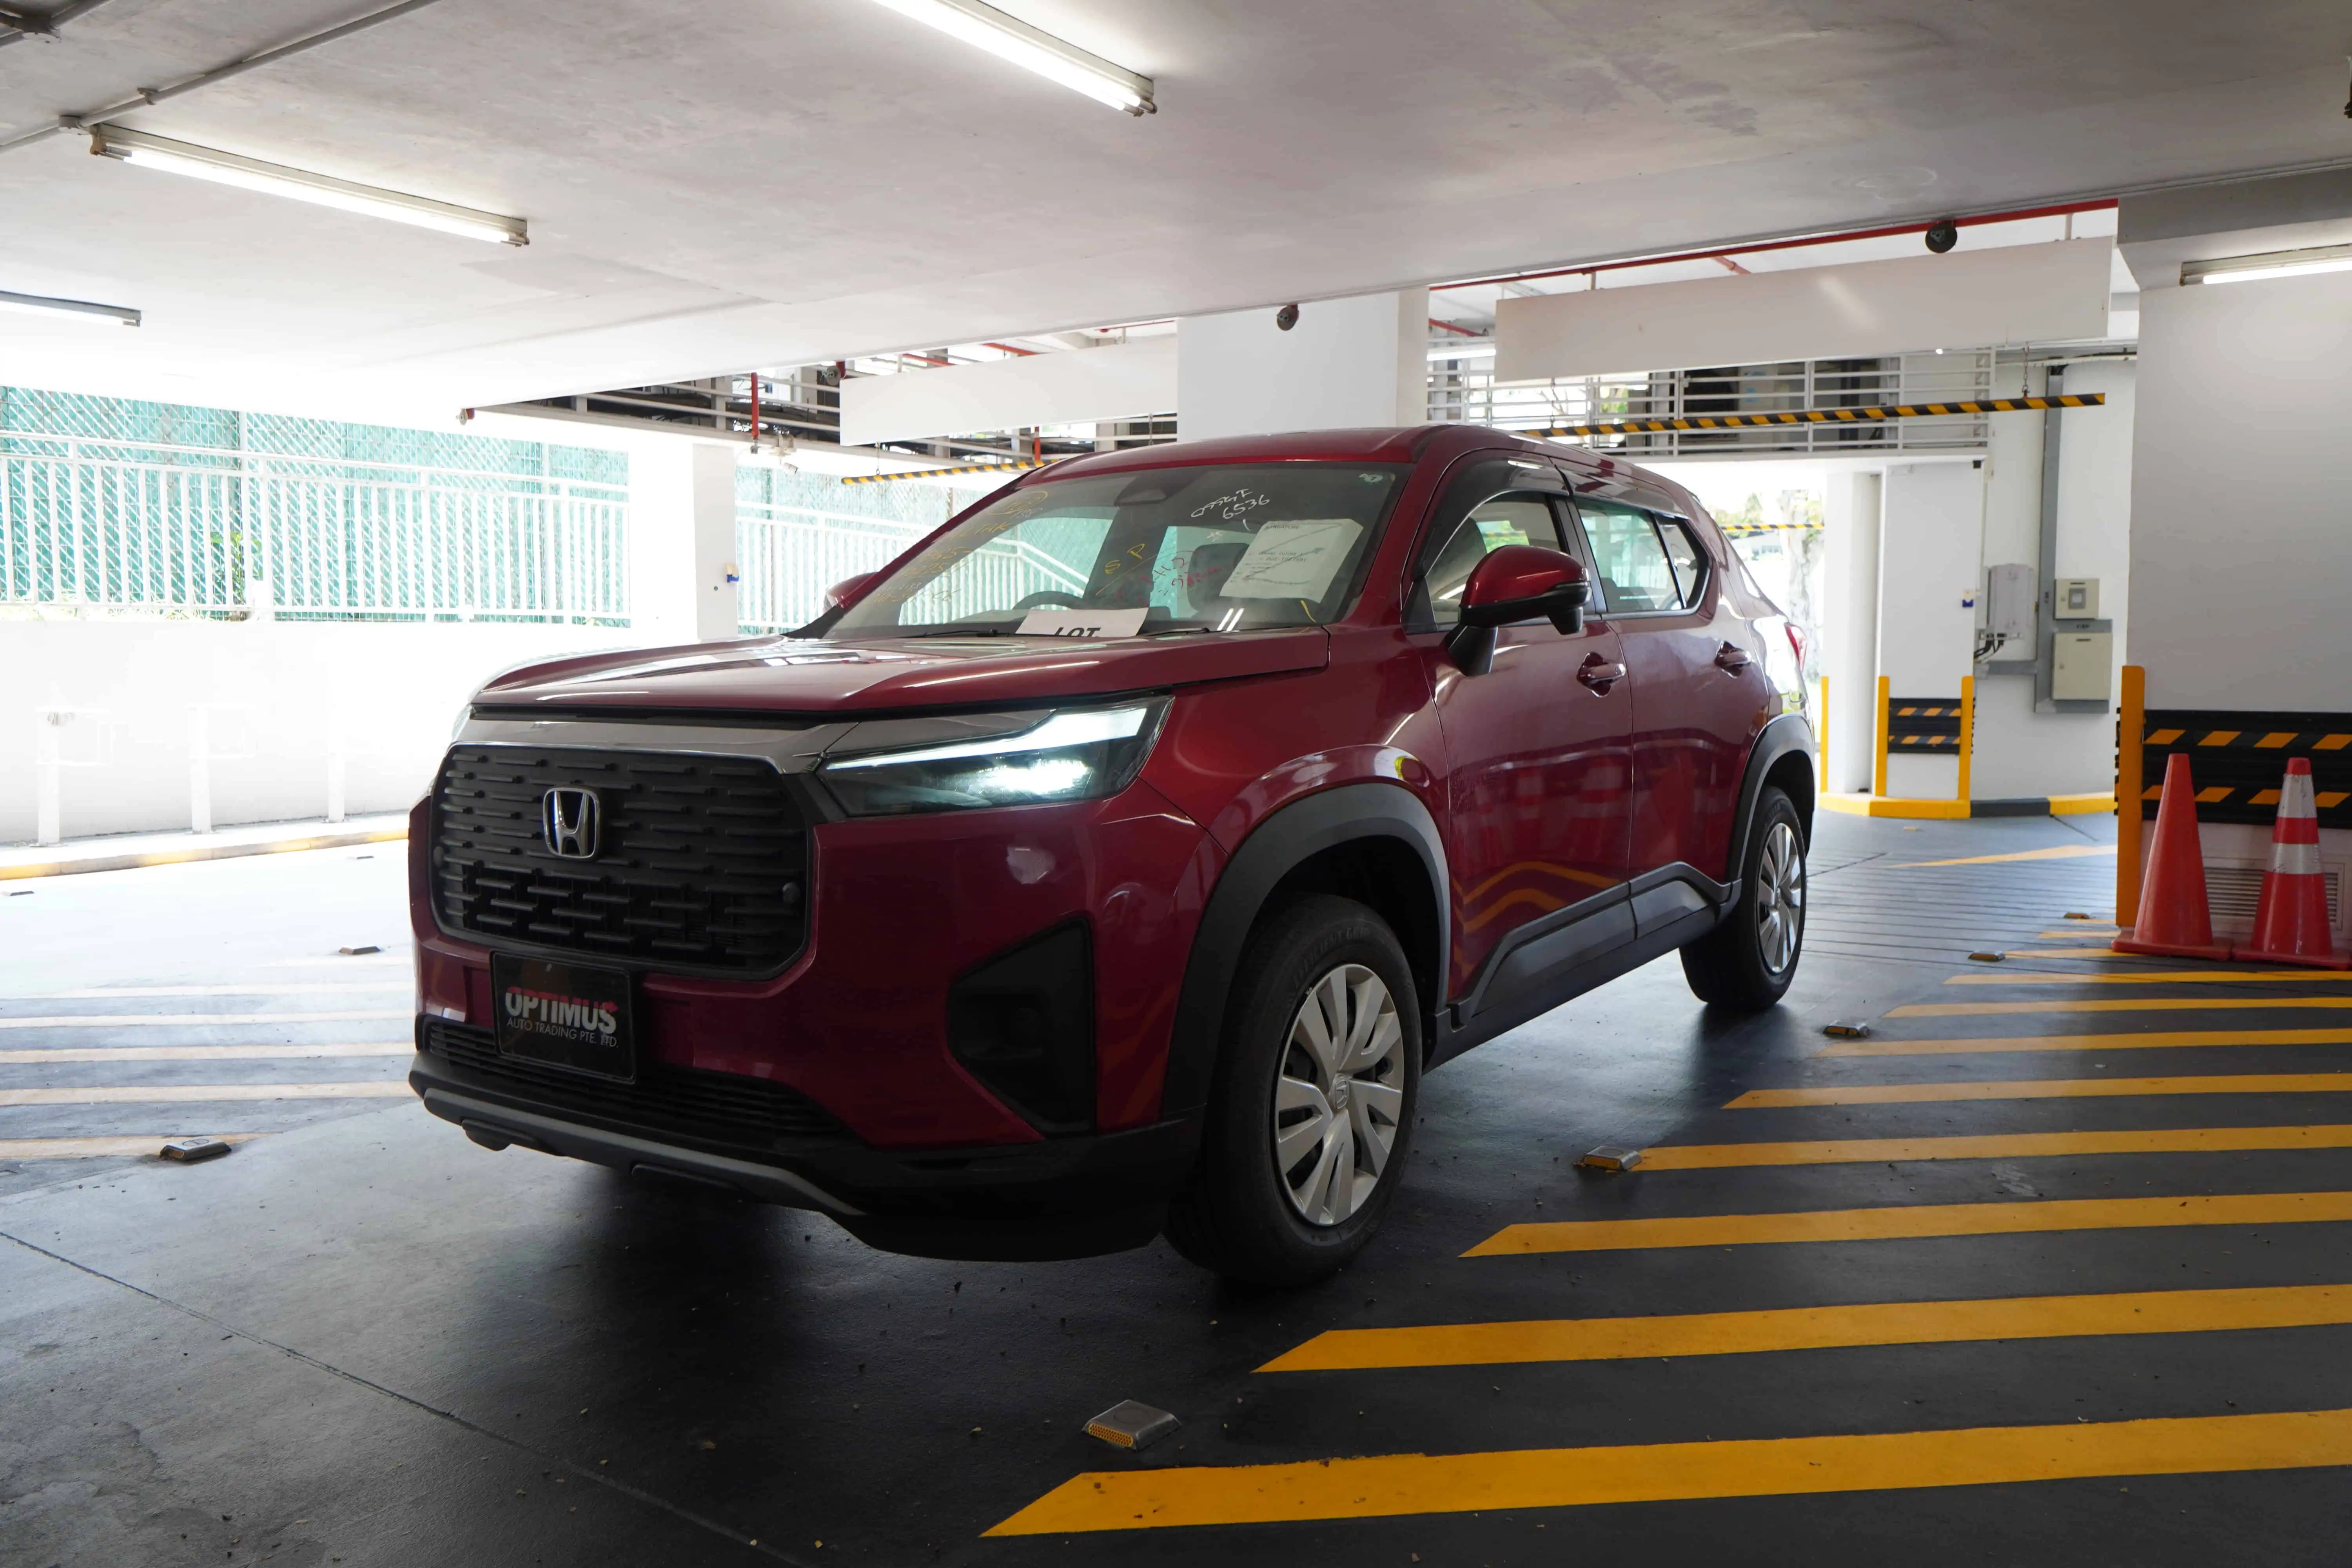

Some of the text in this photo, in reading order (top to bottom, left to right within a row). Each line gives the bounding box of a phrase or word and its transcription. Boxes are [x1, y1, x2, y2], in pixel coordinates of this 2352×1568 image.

[1222, 494, 1270, 519] 6536
[505, 986, 618, 1034] OPTIMUS
[507, 1017, 619, 1048] AUTO TRADING PTE. LTD.
